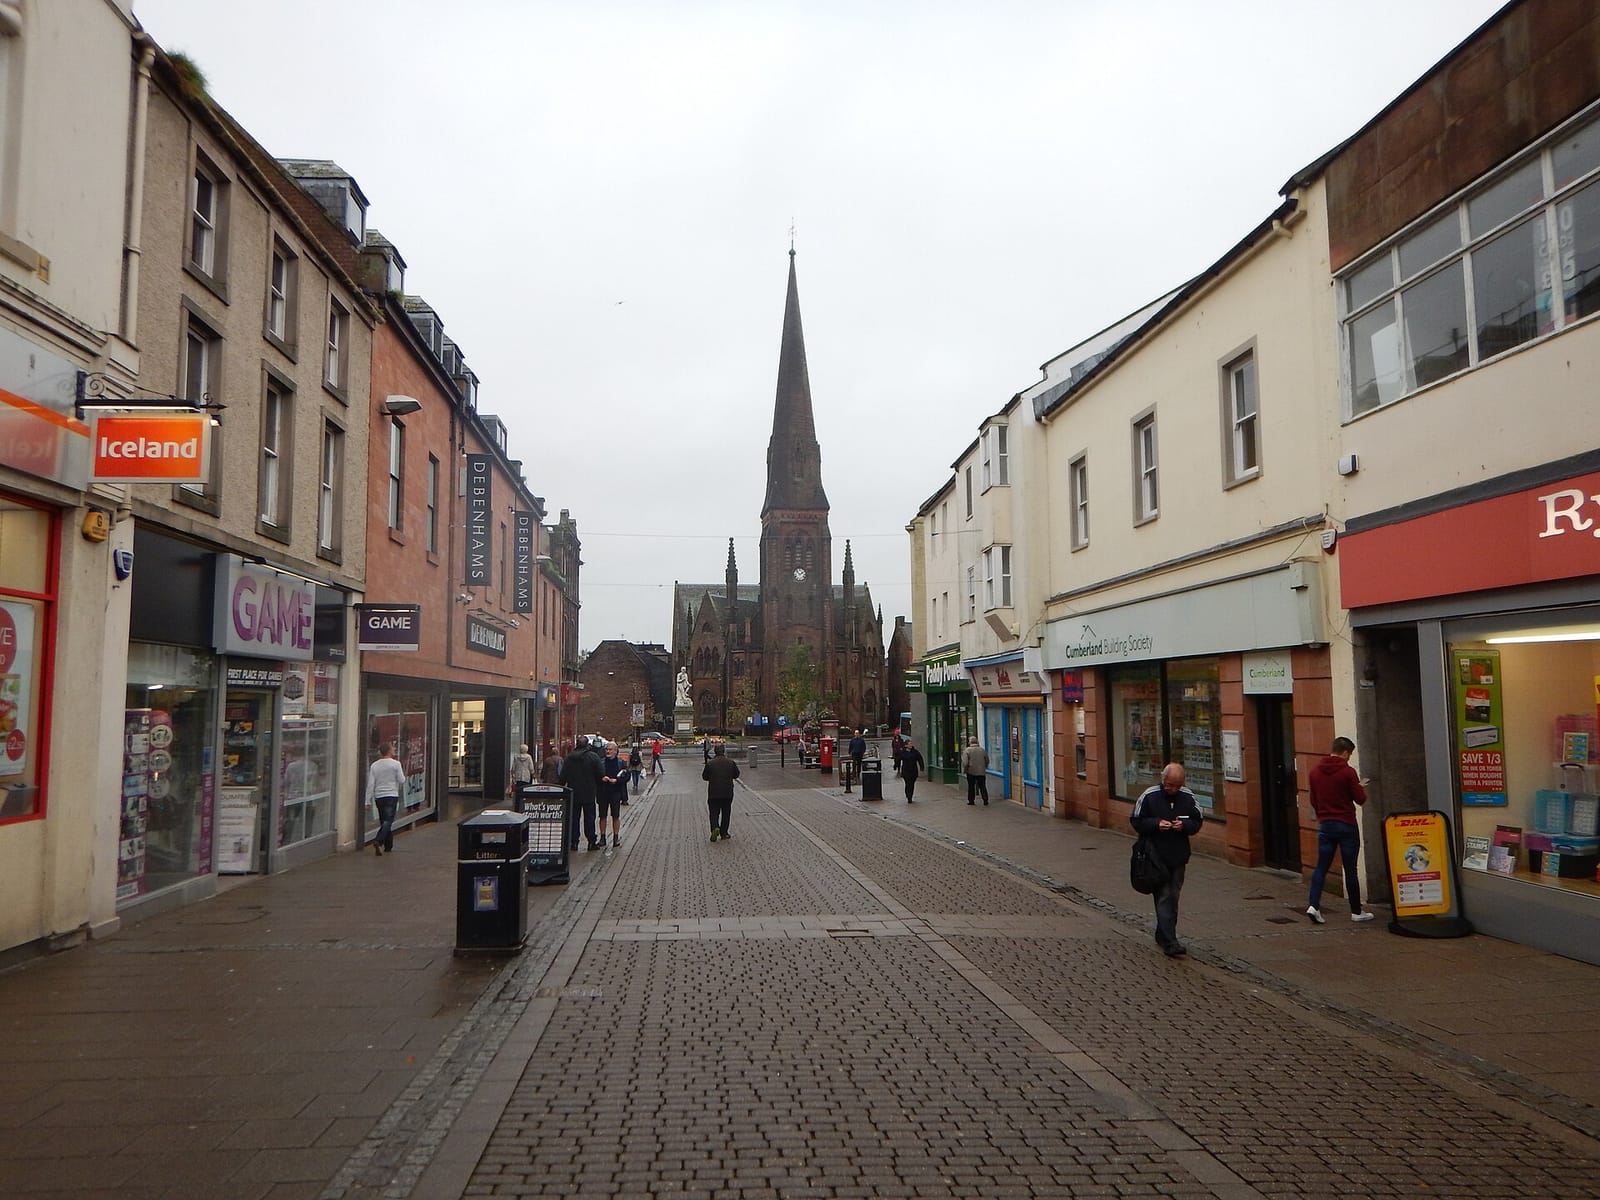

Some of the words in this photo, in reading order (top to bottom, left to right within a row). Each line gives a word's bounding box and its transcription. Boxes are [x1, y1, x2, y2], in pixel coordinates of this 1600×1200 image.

[101, 437, 197, 459] Iceland
[471, 461, 486, 579] DEBENHAMS
[1538, 489, 1600, 538] R
[518, 517, 529, 608] DEBENHAMS
[232, 575, 312, 650] GAME
[368, 616, 411, 630] GAME
[470, 622, 505, 653] DEBENHAMS
[1066, 640, 1103, 659] Cumberland
[1104, 638, 1128, 657] Building
[1129, 634, 1153, 654] Society
[926, 662, 943, 687] Paddy
[943, 660, 961, 682] Powe
[1249, 666, 1285, 679] Cumberland
[1462, 753, 1484, 764] SAVE
[1486, 753, 1501, 765] 1/3
[524, 802, 546, 811] What's
[546, 804, 562, 812] your
[540, 811, 563, 819] worth?
[1399, 818, 1429, 827] DHL
[476, 851, 497, 859] Litter
